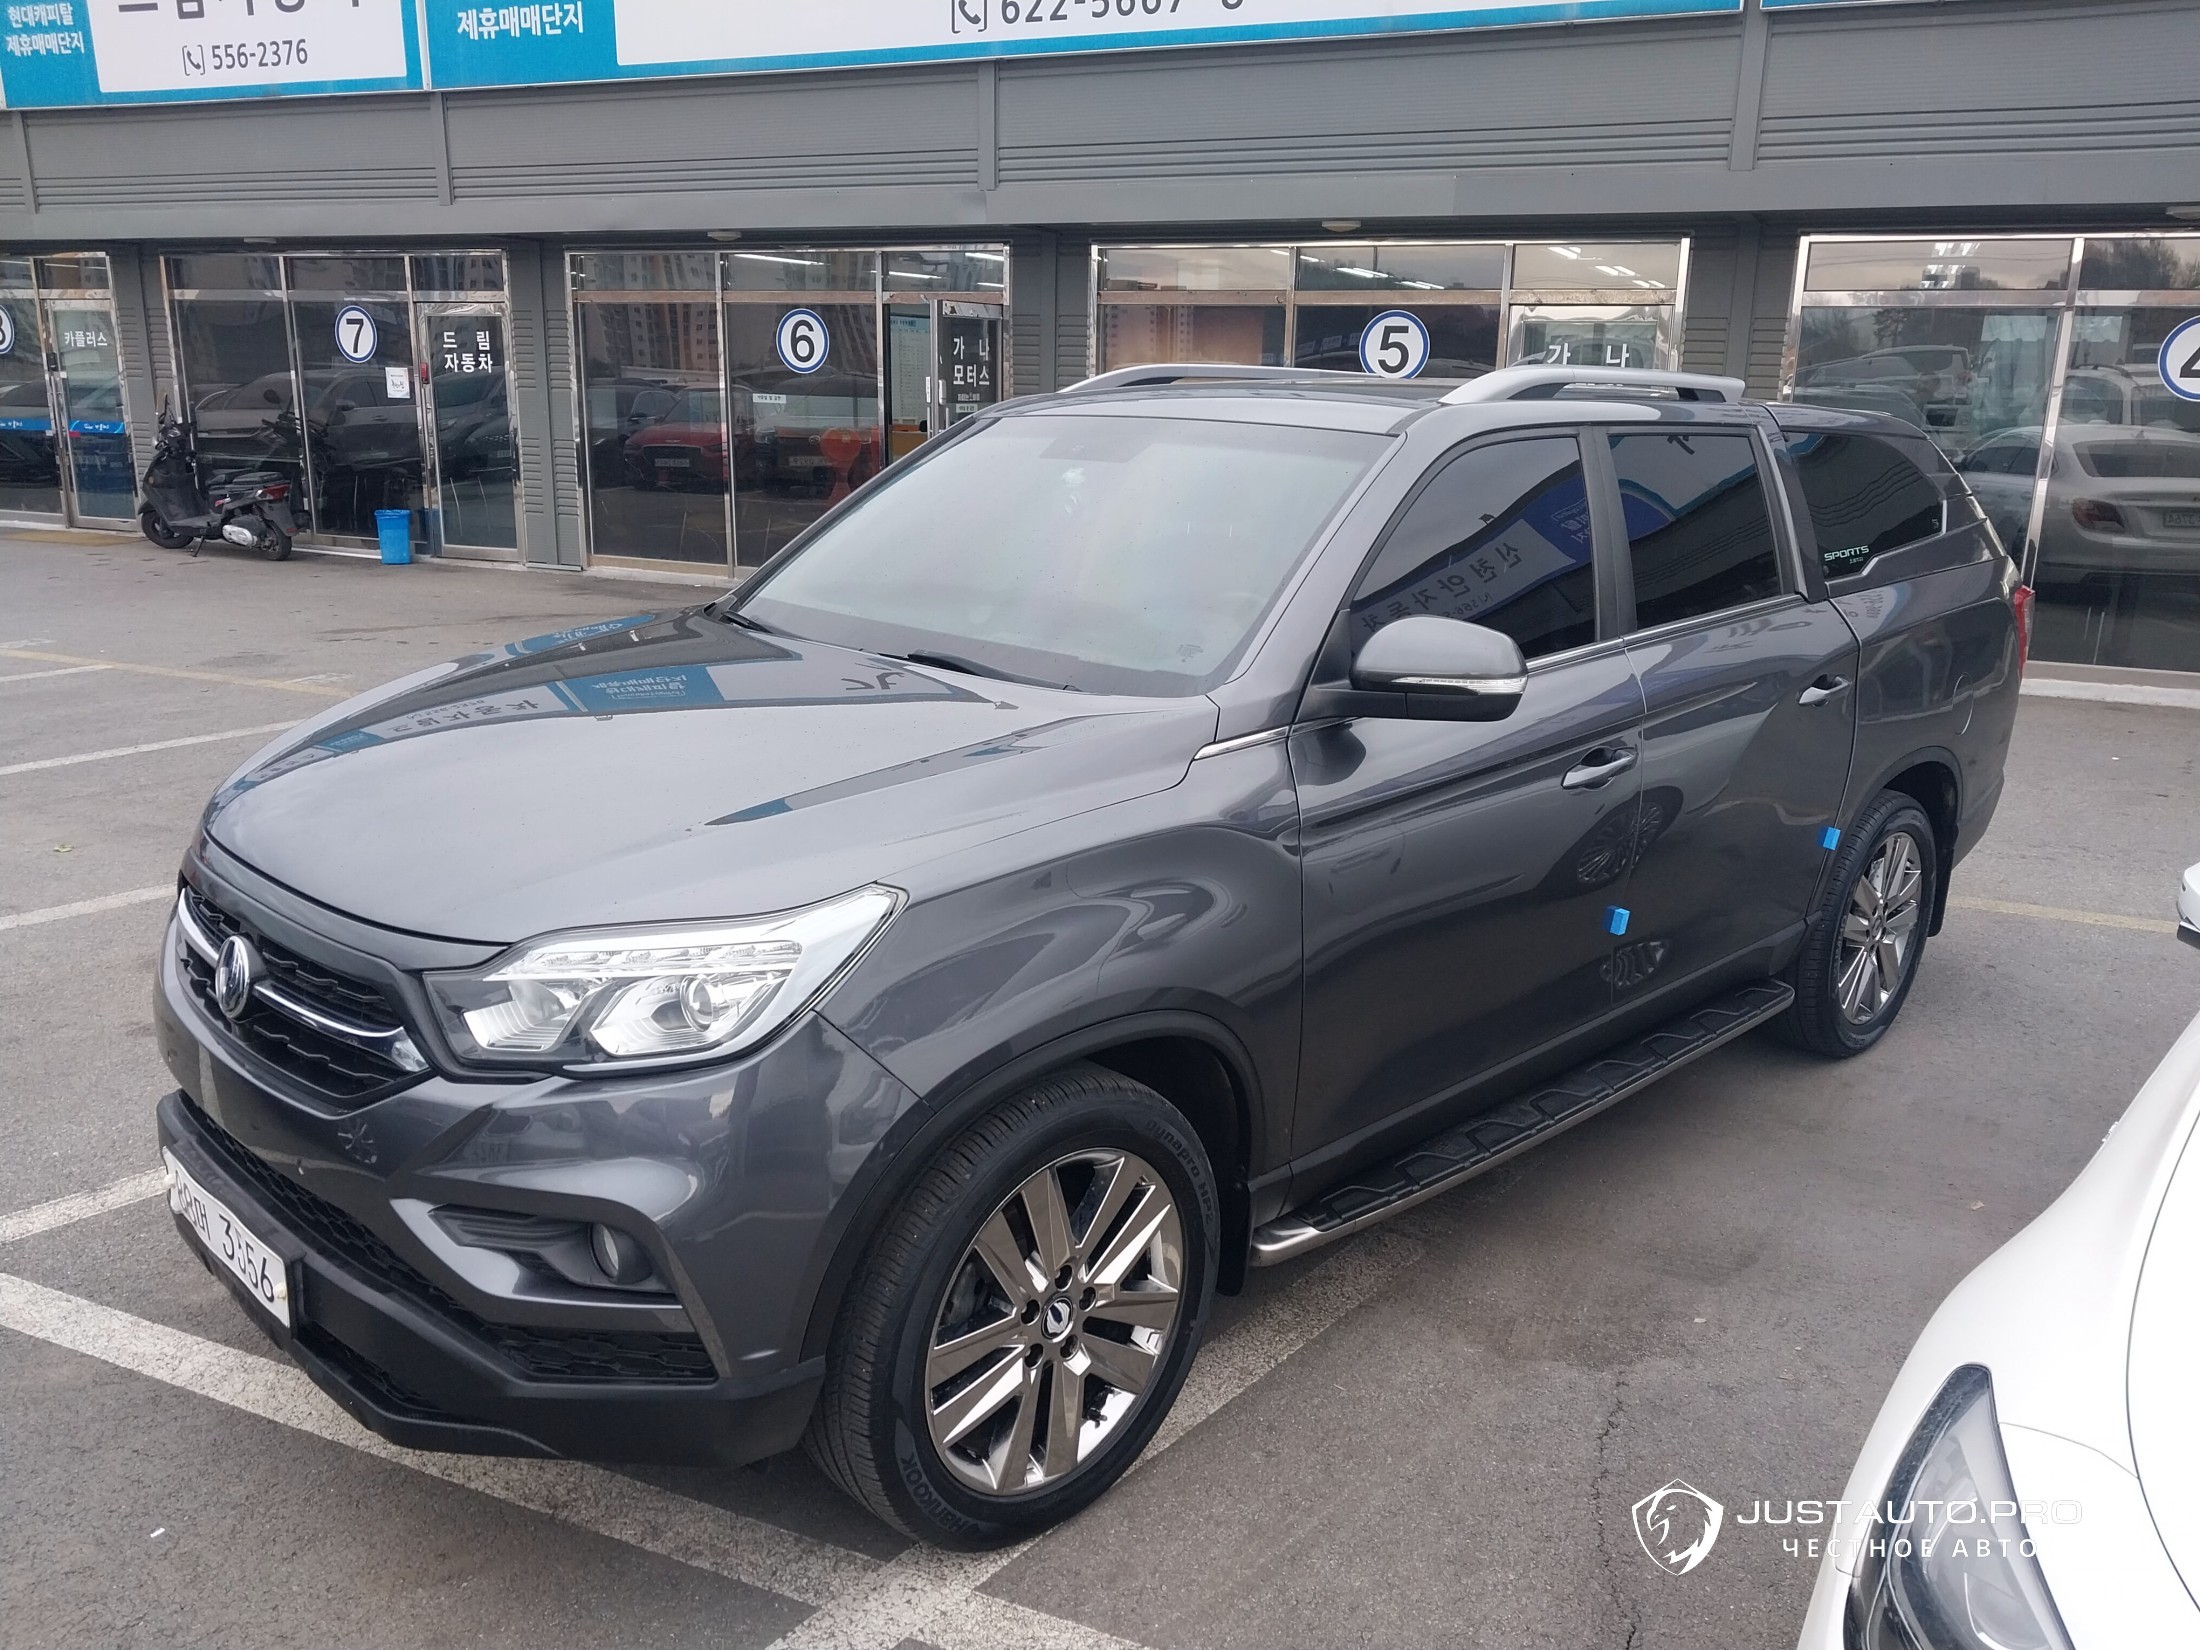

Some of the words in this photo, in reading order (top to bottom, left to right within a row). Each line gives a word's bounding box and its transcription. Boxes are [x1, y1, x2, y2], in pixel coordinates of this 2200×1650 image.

[8, 3, 73, 28] 현대캐피탈
[457, 1, 584, 41] 제휴매매단지
[6, 31, 84, 57] 제휴매매단지
[211, 39, 308, 70] 556-2376
[63, 331, 108, 347] 카플러스
[345, 318, 364, 354] 7
[790, 319, 815, 363] 6
[1377, 325, 1410, 374] 5
[444, 352, 494, 373] 자동차
[953, 363, 990, 388] 모터스
[1824, 545, 1870, 562] SPORTS
[218, 1212, 275, 1303] 3556
